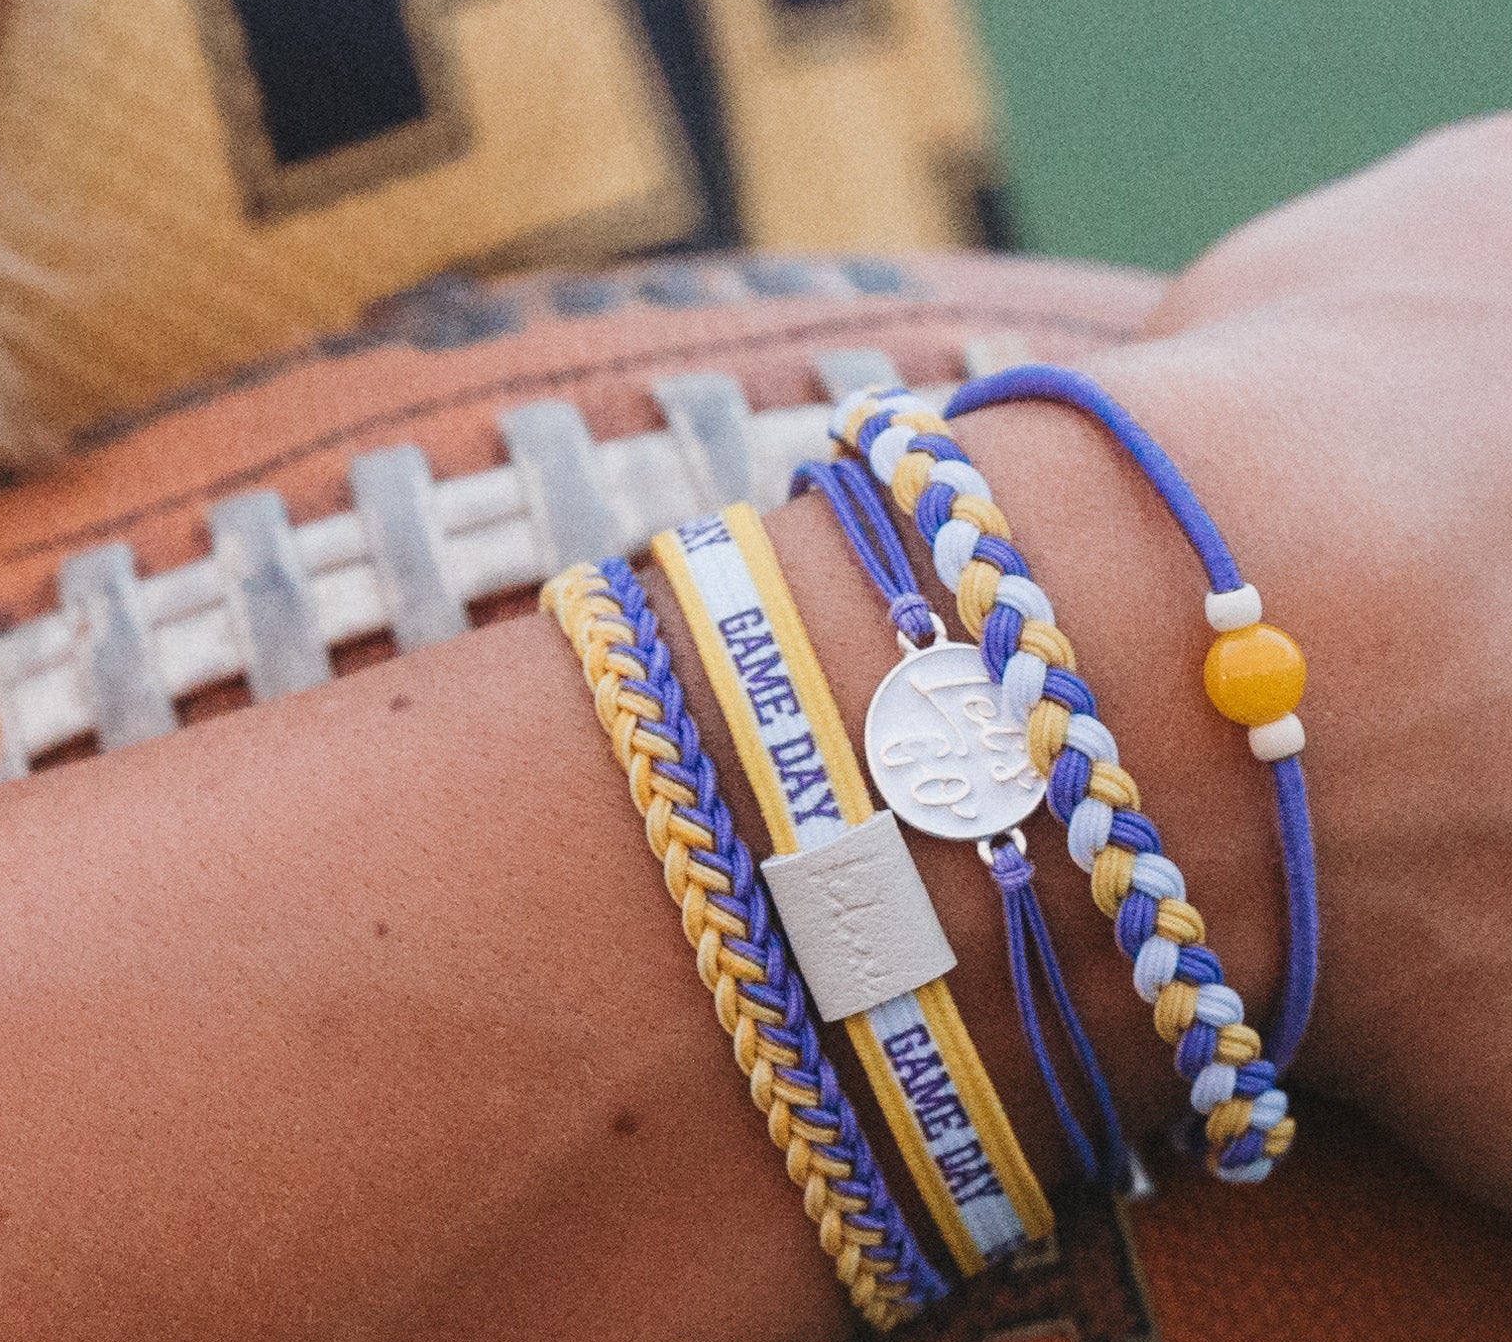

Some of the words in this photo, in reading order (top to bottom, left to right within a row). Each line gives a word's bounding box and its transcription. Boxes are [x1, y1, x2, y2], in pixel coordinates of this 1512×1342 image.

[718, 607, 801, 727] GAME
[769, 731, 843, 826] DAY
[883, 1023, 972, 1142] GAME
[937, 1139, 1004, 1206] DAY
